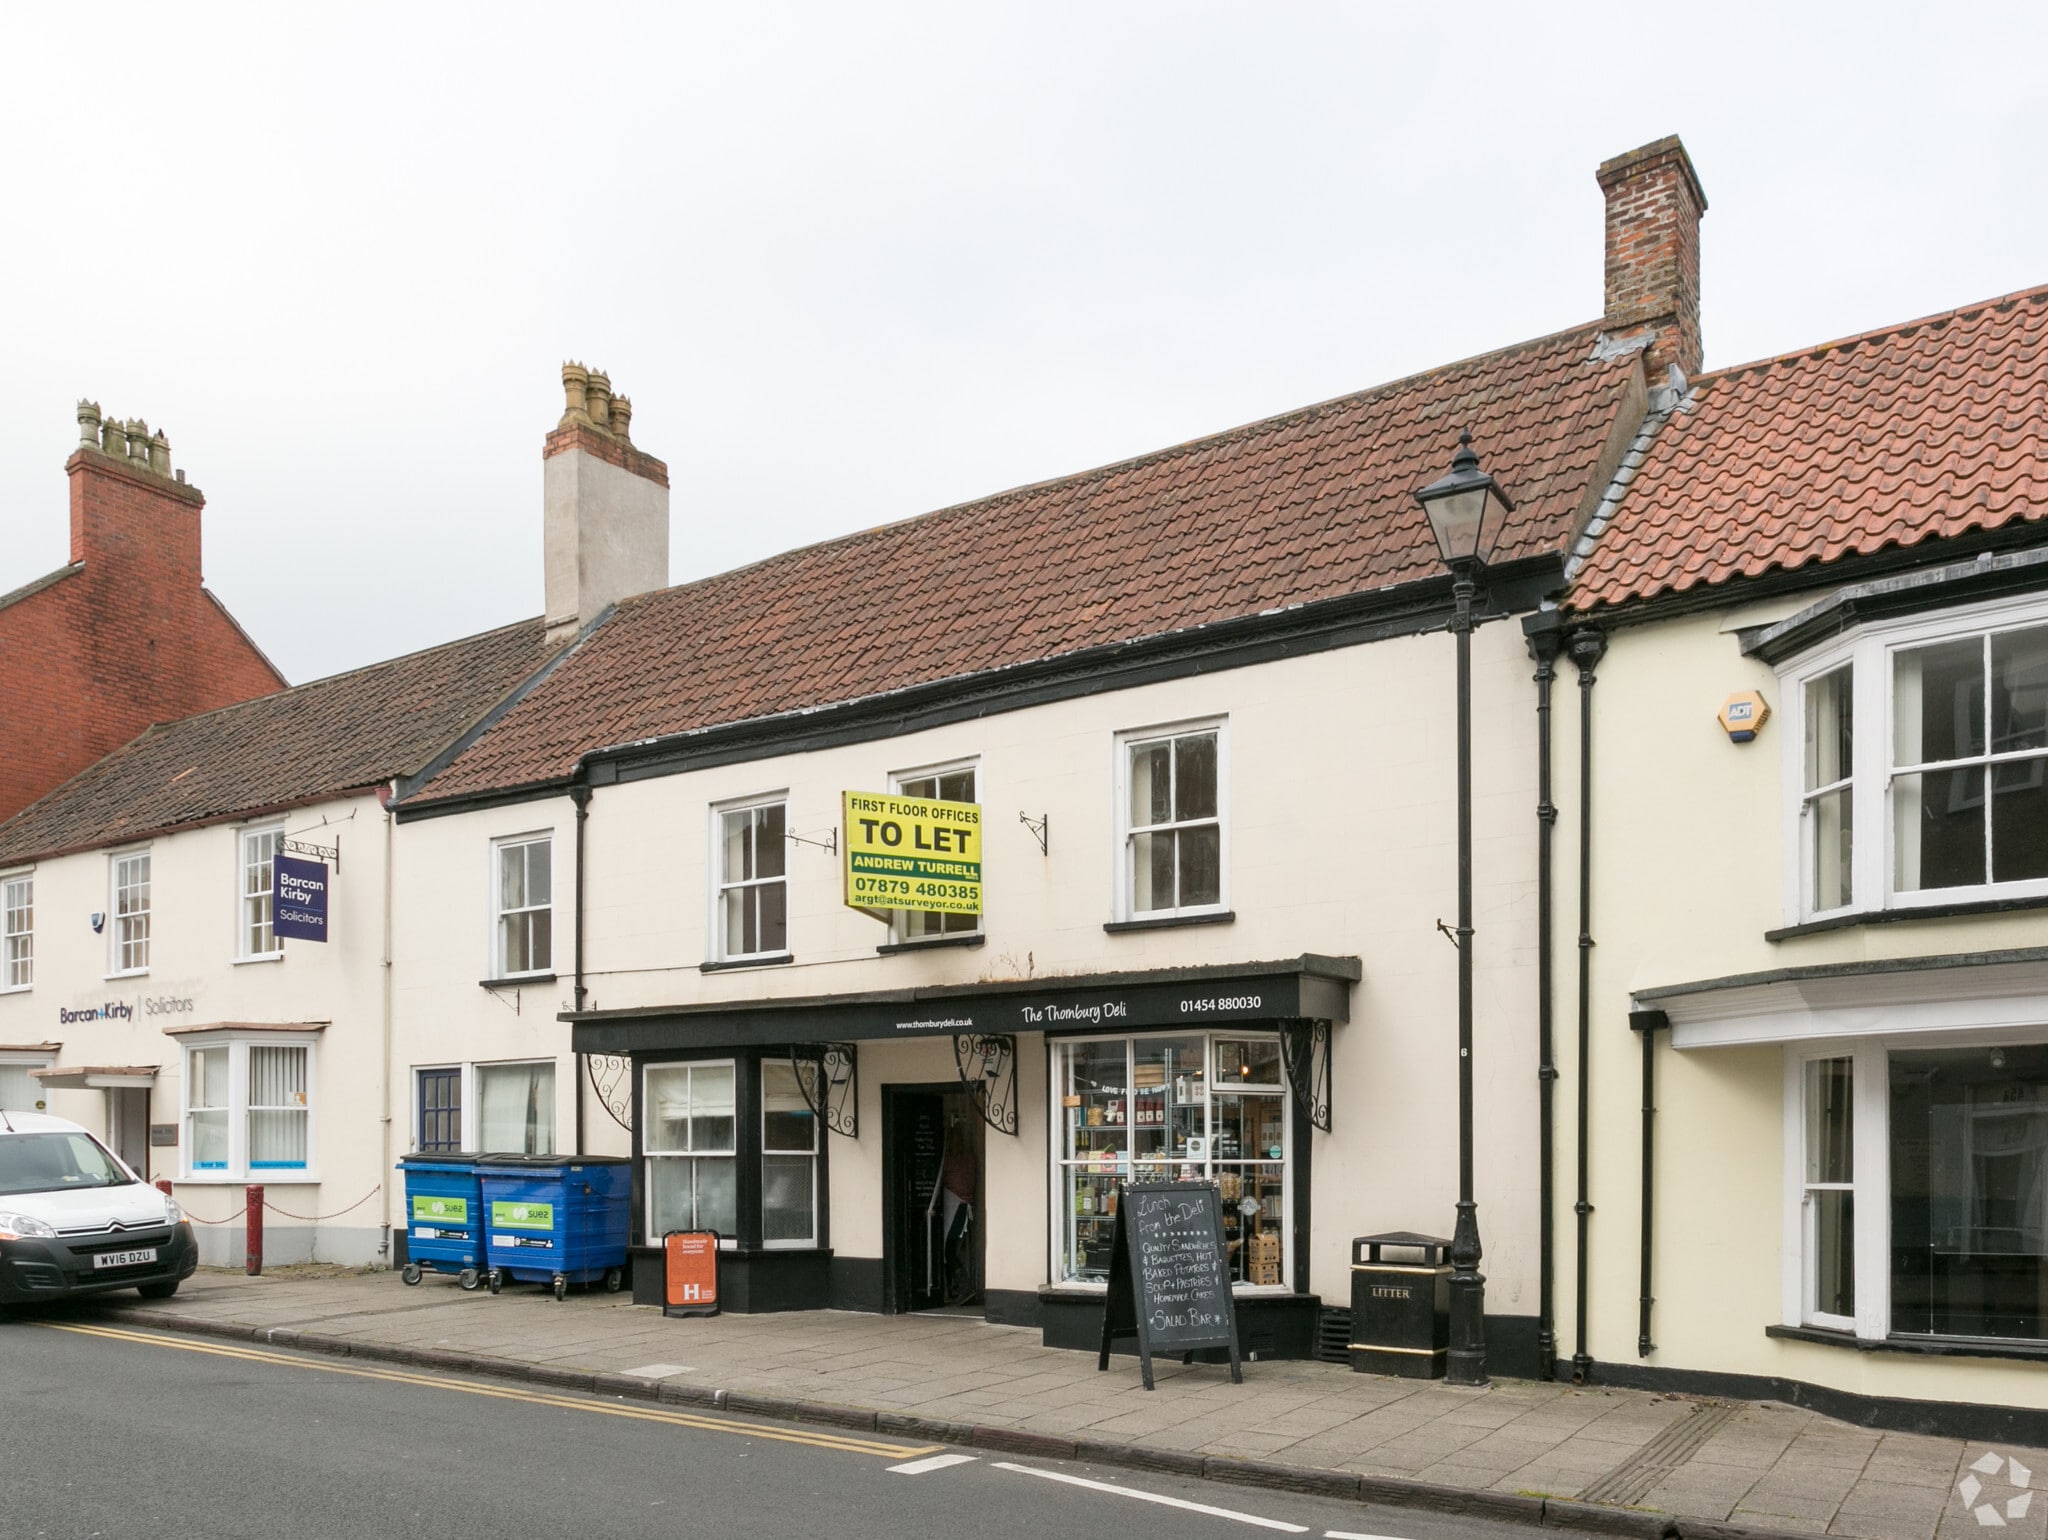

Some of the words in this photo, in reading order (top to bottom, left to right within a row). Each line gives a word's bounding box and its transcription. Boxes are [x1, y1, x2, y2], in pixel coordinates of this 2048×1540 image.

[1729, 705, 1752, 718] ADT
[851, 798, 886, 813] FIRST
[889, 803, 928, 818] FLOOR
[931, 807, 979, 824] OFFICES
[859, 818, 903, 847] TO
[915, 824, 972, 854] LET
[854, 855, 914, 872] ANDREW
[917, 861, 978, 877] TURRELL
[280, 873, 324, 891] Barcan
[855, 877, 910, 895] 07879
[915, 882, 979, 900] 480385
[280, 886, 312, 905] Kirby
[854, 894, 979, 911] argt@atsurveyor.co.uk
[280, 909, 323, 925] Solicitors
[145, 996, 193, 1016] Solicitors
[1021, 1006, 1043, 1023] The
[1045, 1004, 1101, 1024] Thornbury
[1103, 1001, 1127, 1018] Deli
[1180, 999, 1216, 1012] 01454
[1218, 996, 1261, 1010] 880030
[896, 1017, 973, 1030] www.thornburydeli.co.uk
[444, 1203, 463, 1213] suez
[528, 1210, 549, 1219] suez
[1137, 1195, 1171, 1217] Lunch
[1164, 1212, 1180, 1226] the
[1178, 1199, 1204, 1220] Deli
[100, 1253, 126, 1265] WV16
[129, 1251, 150, 1263] DZU
[683, 1284, 700, 1300] H
[1372, 1287, 1410, 1299] LITTER
[1154, 1309, 1187, 1331] SALAD
[1187, 1307, 1214, 1327] BAR
